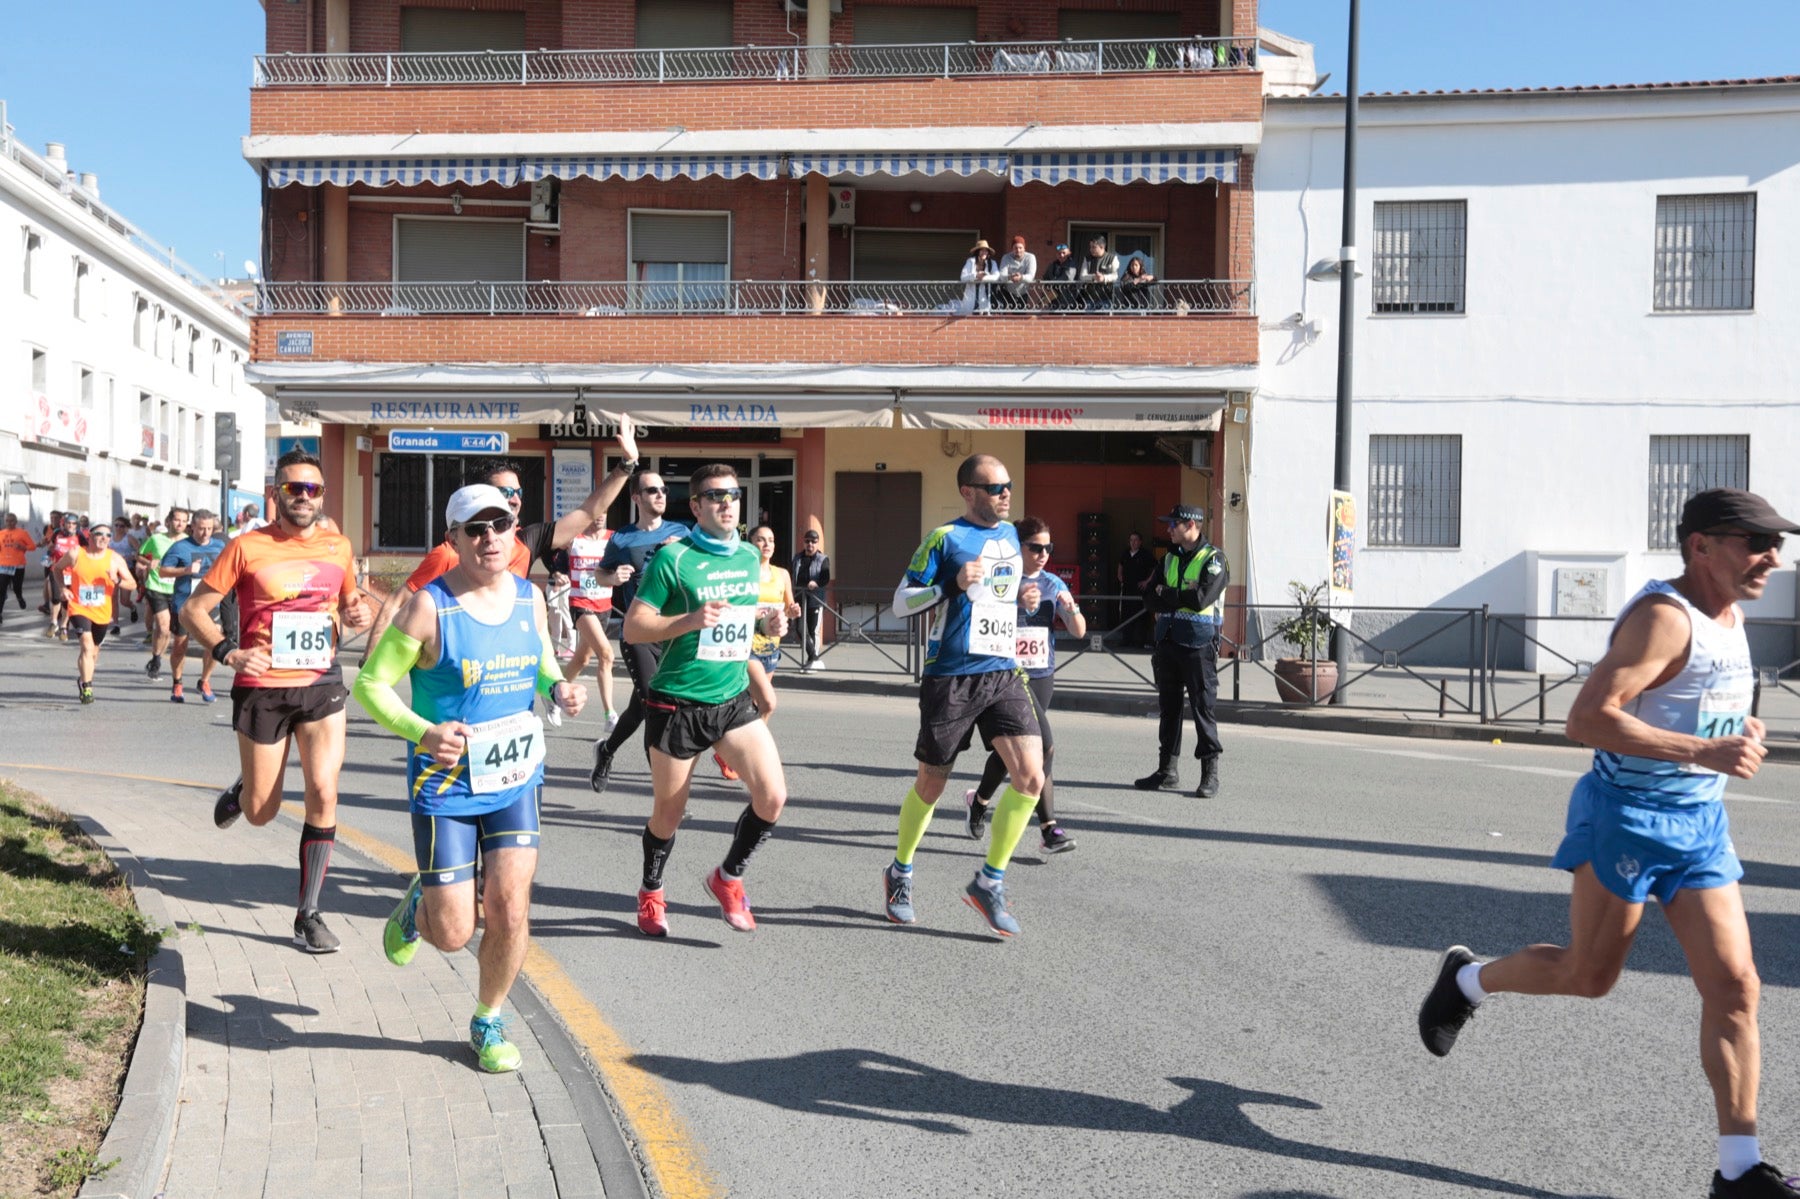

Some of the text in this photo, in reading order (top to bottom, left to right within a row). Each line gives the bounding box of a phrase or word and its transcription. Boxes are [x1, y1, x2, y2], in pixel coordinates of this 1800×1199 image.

[371, 402, 520, 419] RESTAURANTE
[690, 403, 778, 422] PARADA
[1147, 413, 1178, 422] CERVEZAS
[550, 423, 649, 438] BICHITS
[392, 436, 438, 447] Granada
[707, 570, 748, 581] atletismo
[712, 623, 747, 643] 664
[979, 618, 1014, 638] 3049
[286, 630, 325, 650] 185
[486, 653, 538, 671] olimpo
[484, 671, 519, 681] deportes
[480, 686, 502, 695] TRAIL
[1704, 715, 1744, 739] 10
[485, 733, 534, 768] 447
